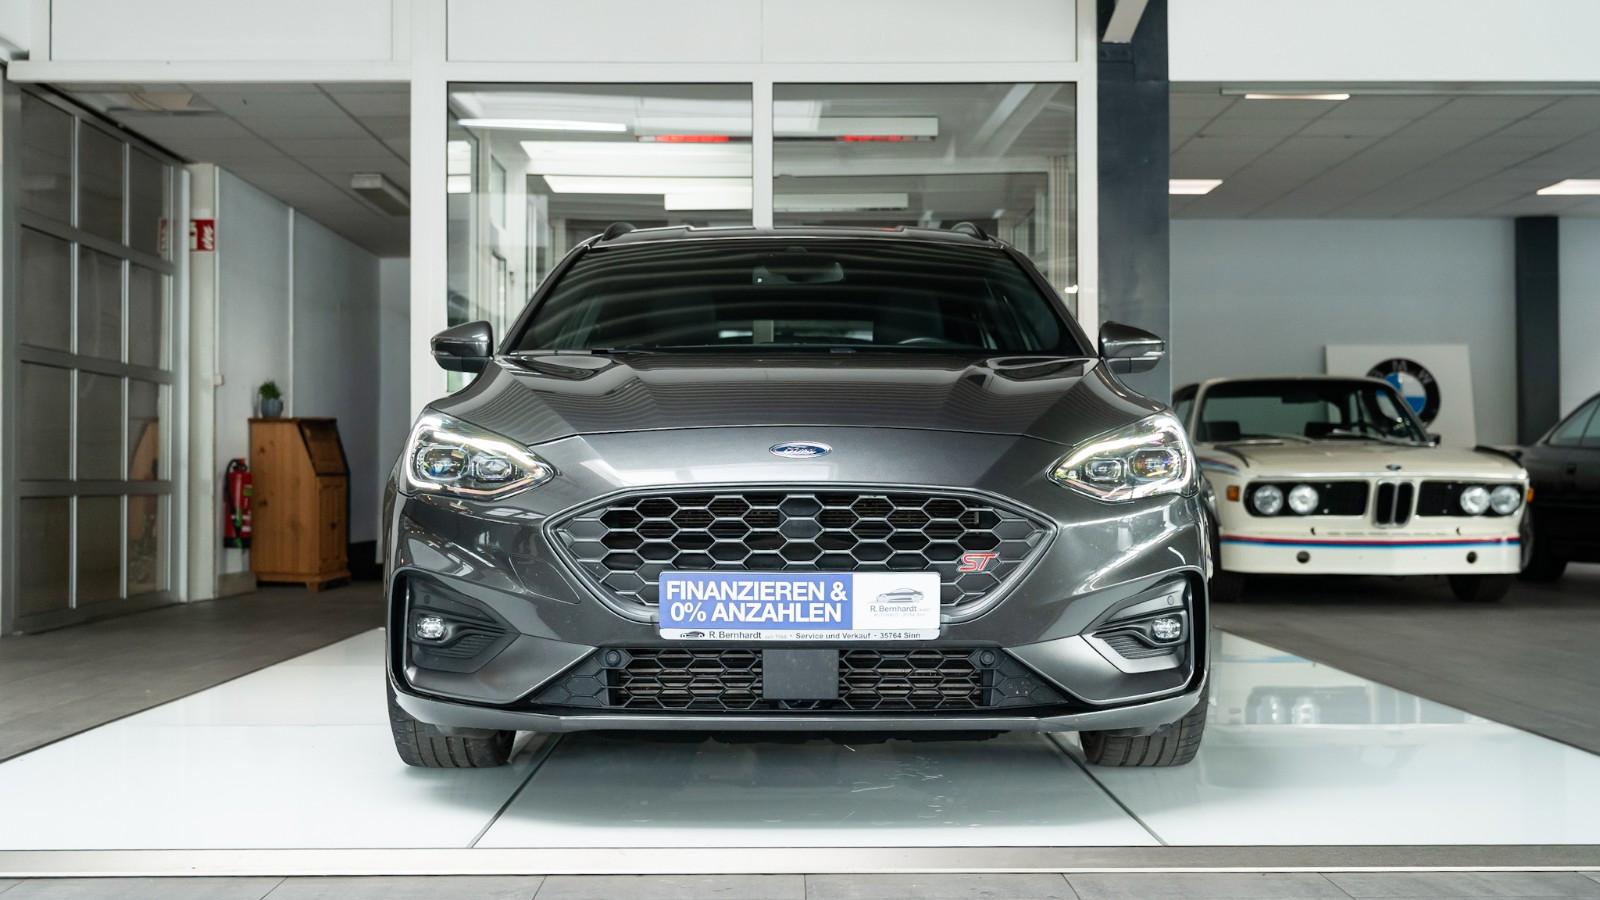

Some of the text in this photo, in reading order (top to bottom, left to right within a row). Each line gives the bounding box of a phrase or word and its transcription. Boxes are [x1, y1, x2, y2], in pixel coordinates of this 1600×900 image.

[957, 552, 1000, 572] ST
[666, 580, 848, 601] FINANZIEREN &
[670, 602, 841, 622] 0% ANZAHLEN
[879, 604, 917, 612] Bernhardt
[719, 631, 761, 639] Bernhardt
